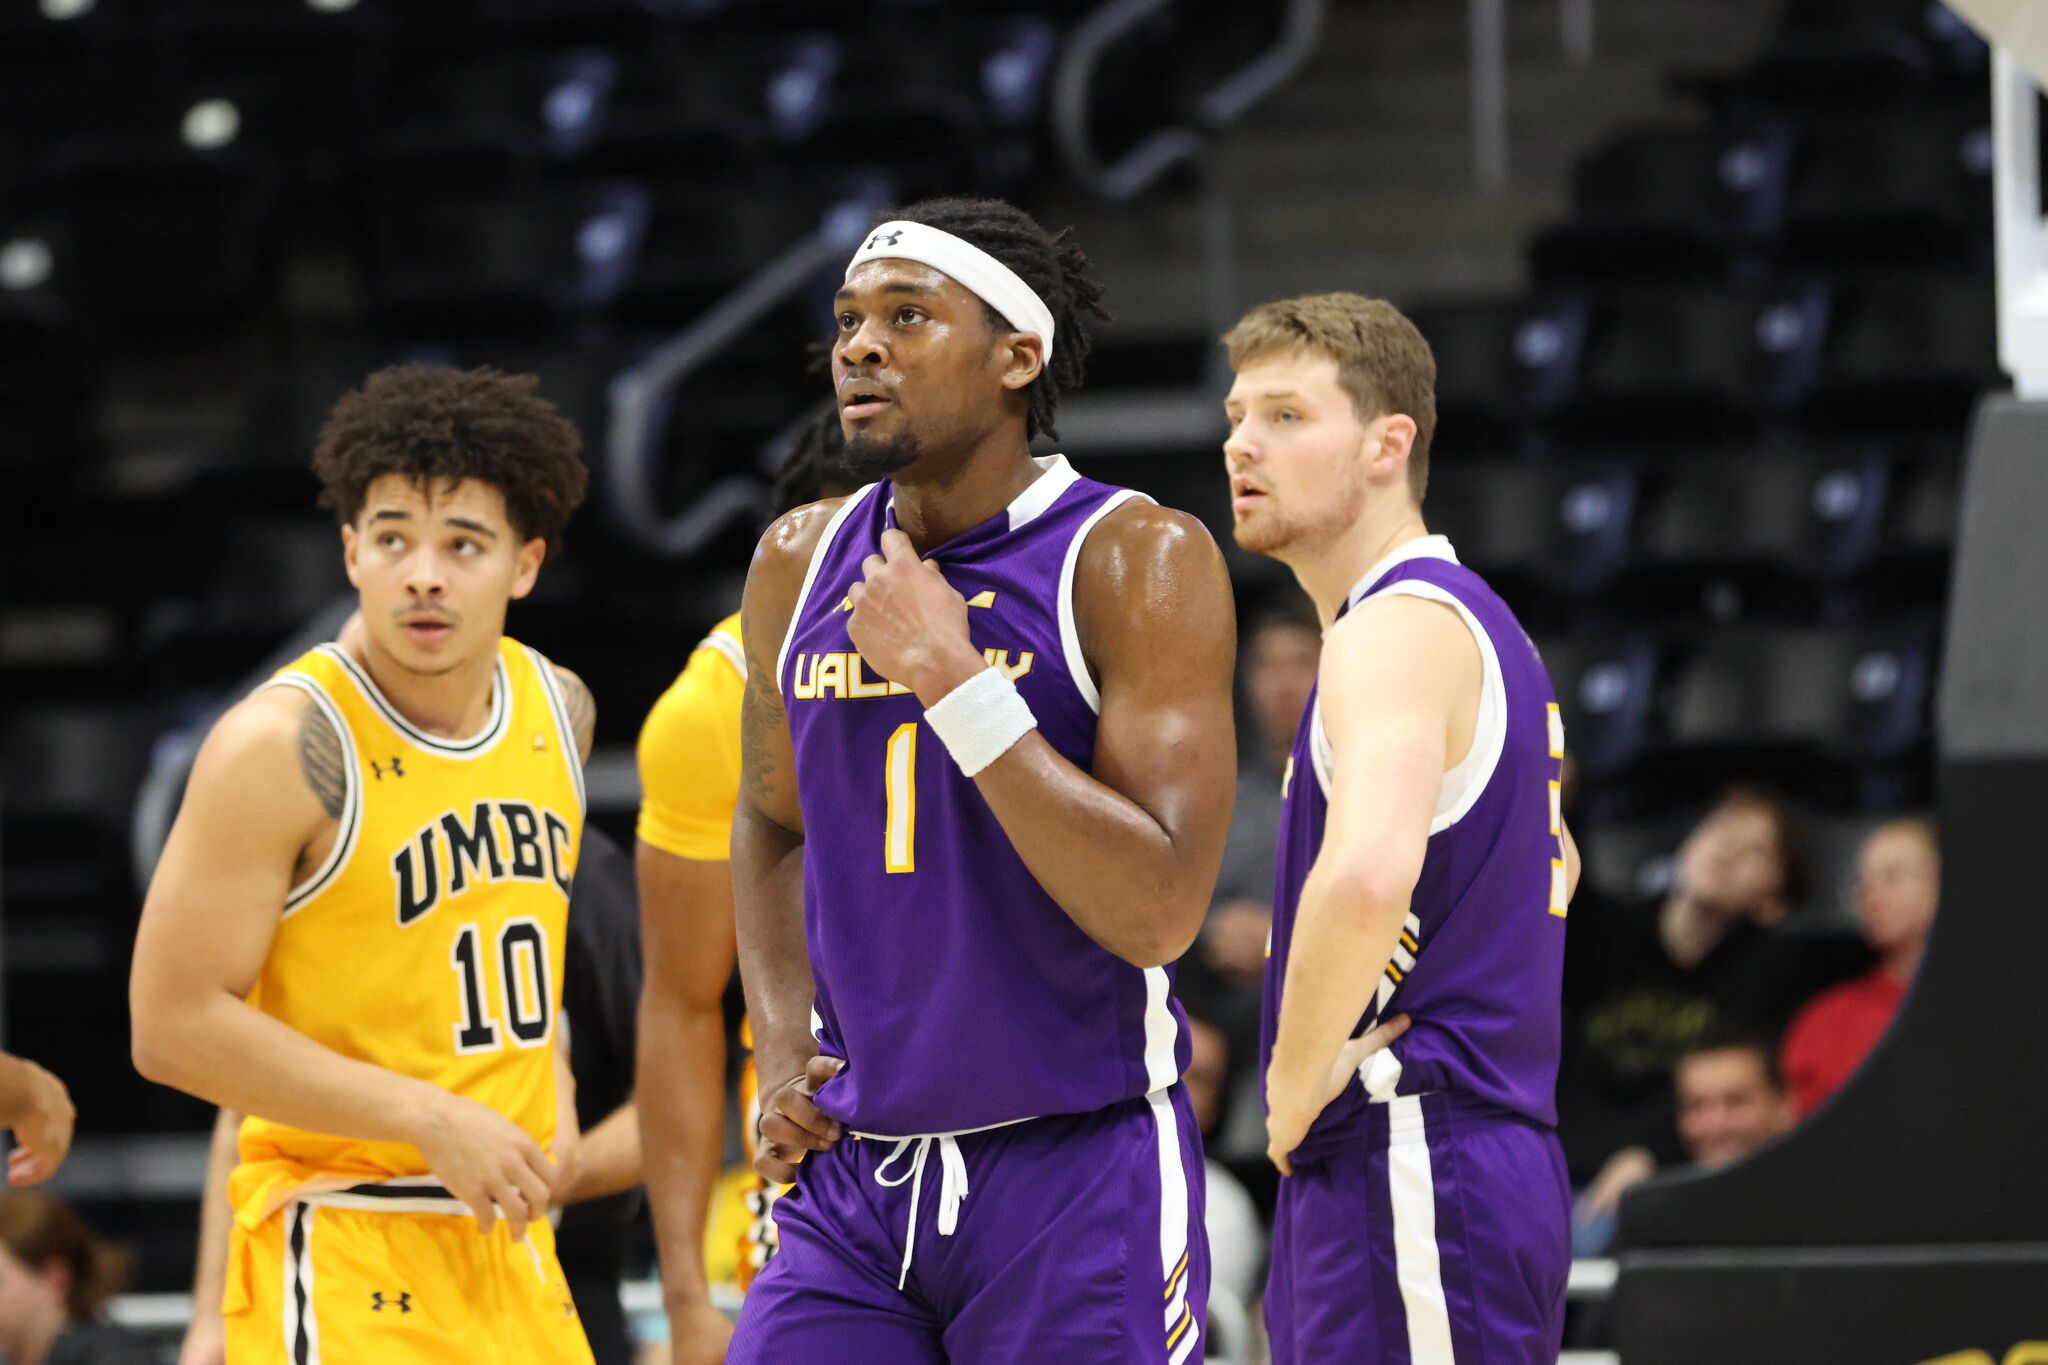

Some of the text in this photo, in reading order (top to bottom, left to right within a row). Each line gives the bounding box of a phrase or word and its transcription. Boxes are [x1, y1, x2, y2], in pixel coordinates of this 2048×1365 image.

[794, 648, 1034, 699] UALY
[392, 799, 571, 926] UMBC
[885, 722, 917, 874] 1
[452, 917, 553, 1054] 10
